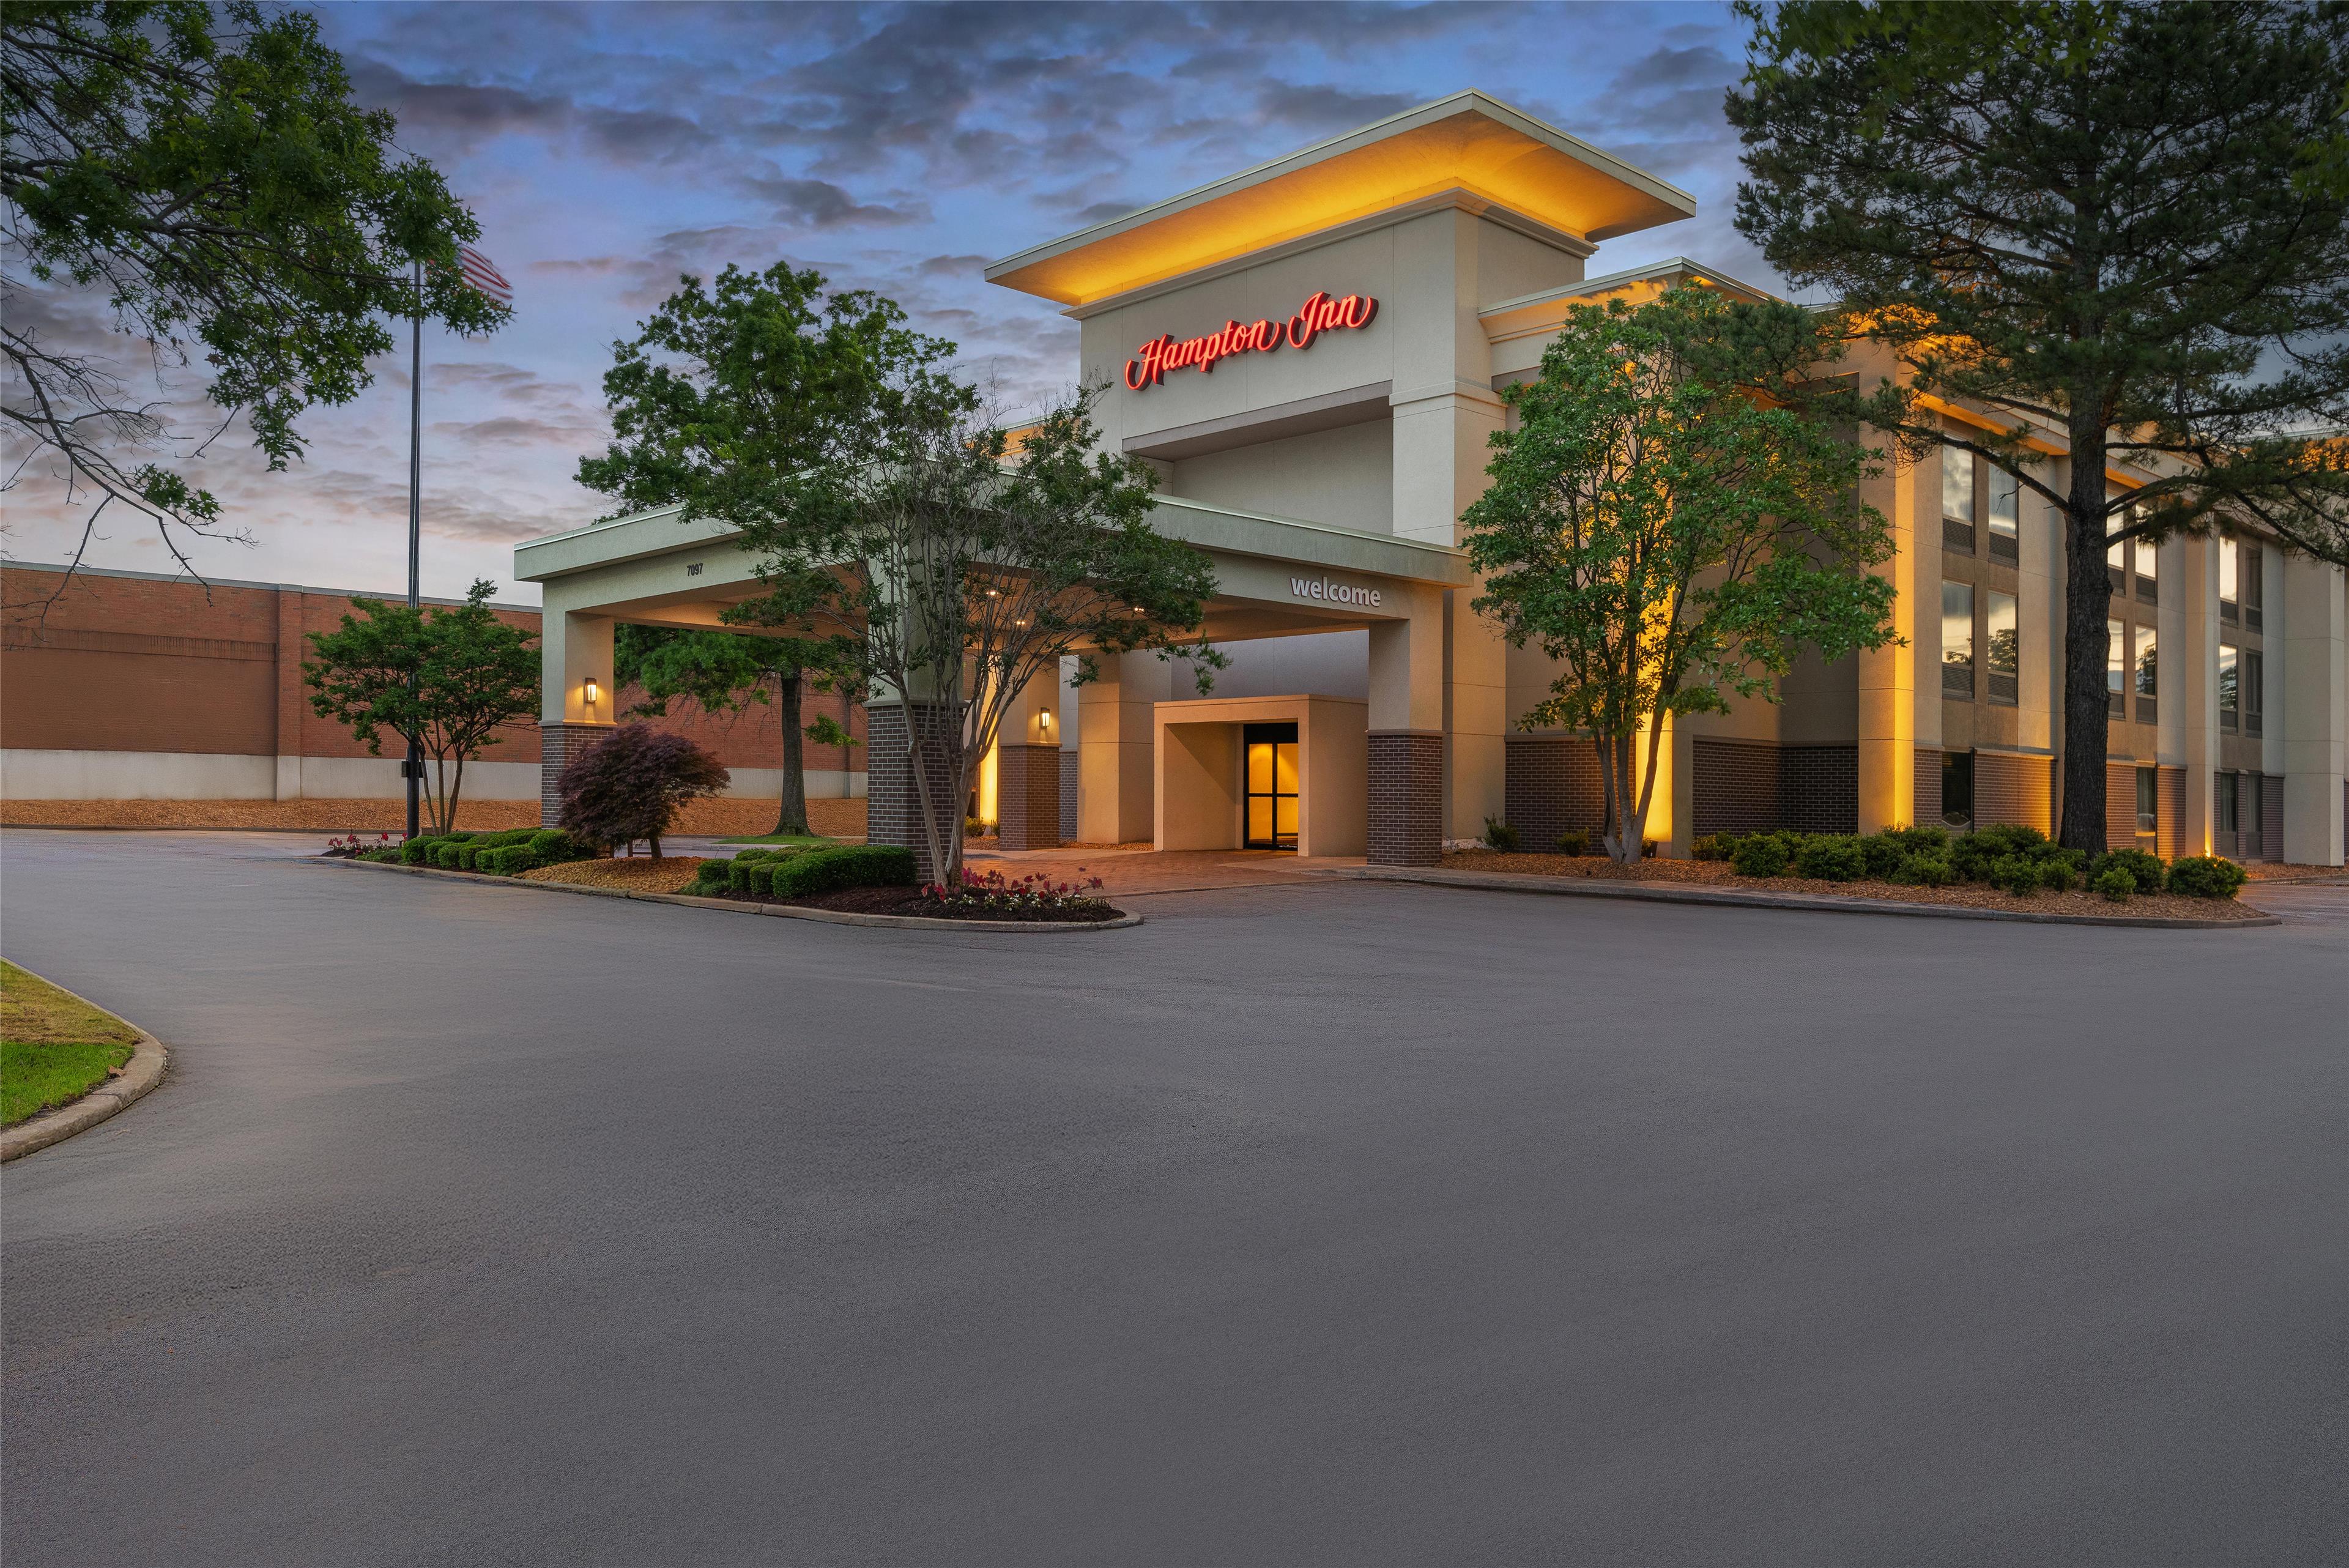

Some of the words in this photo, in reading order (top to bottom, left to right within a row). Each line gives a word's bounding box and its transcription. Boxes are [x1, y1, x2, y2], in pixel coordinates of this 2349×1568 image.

[1124, 319, 1286, 391] Hampton
[1287, 291, 1379, 350] Inn
[686, 562, 703, 577] 7097
[1290, 576, 1381, 607] welcome
